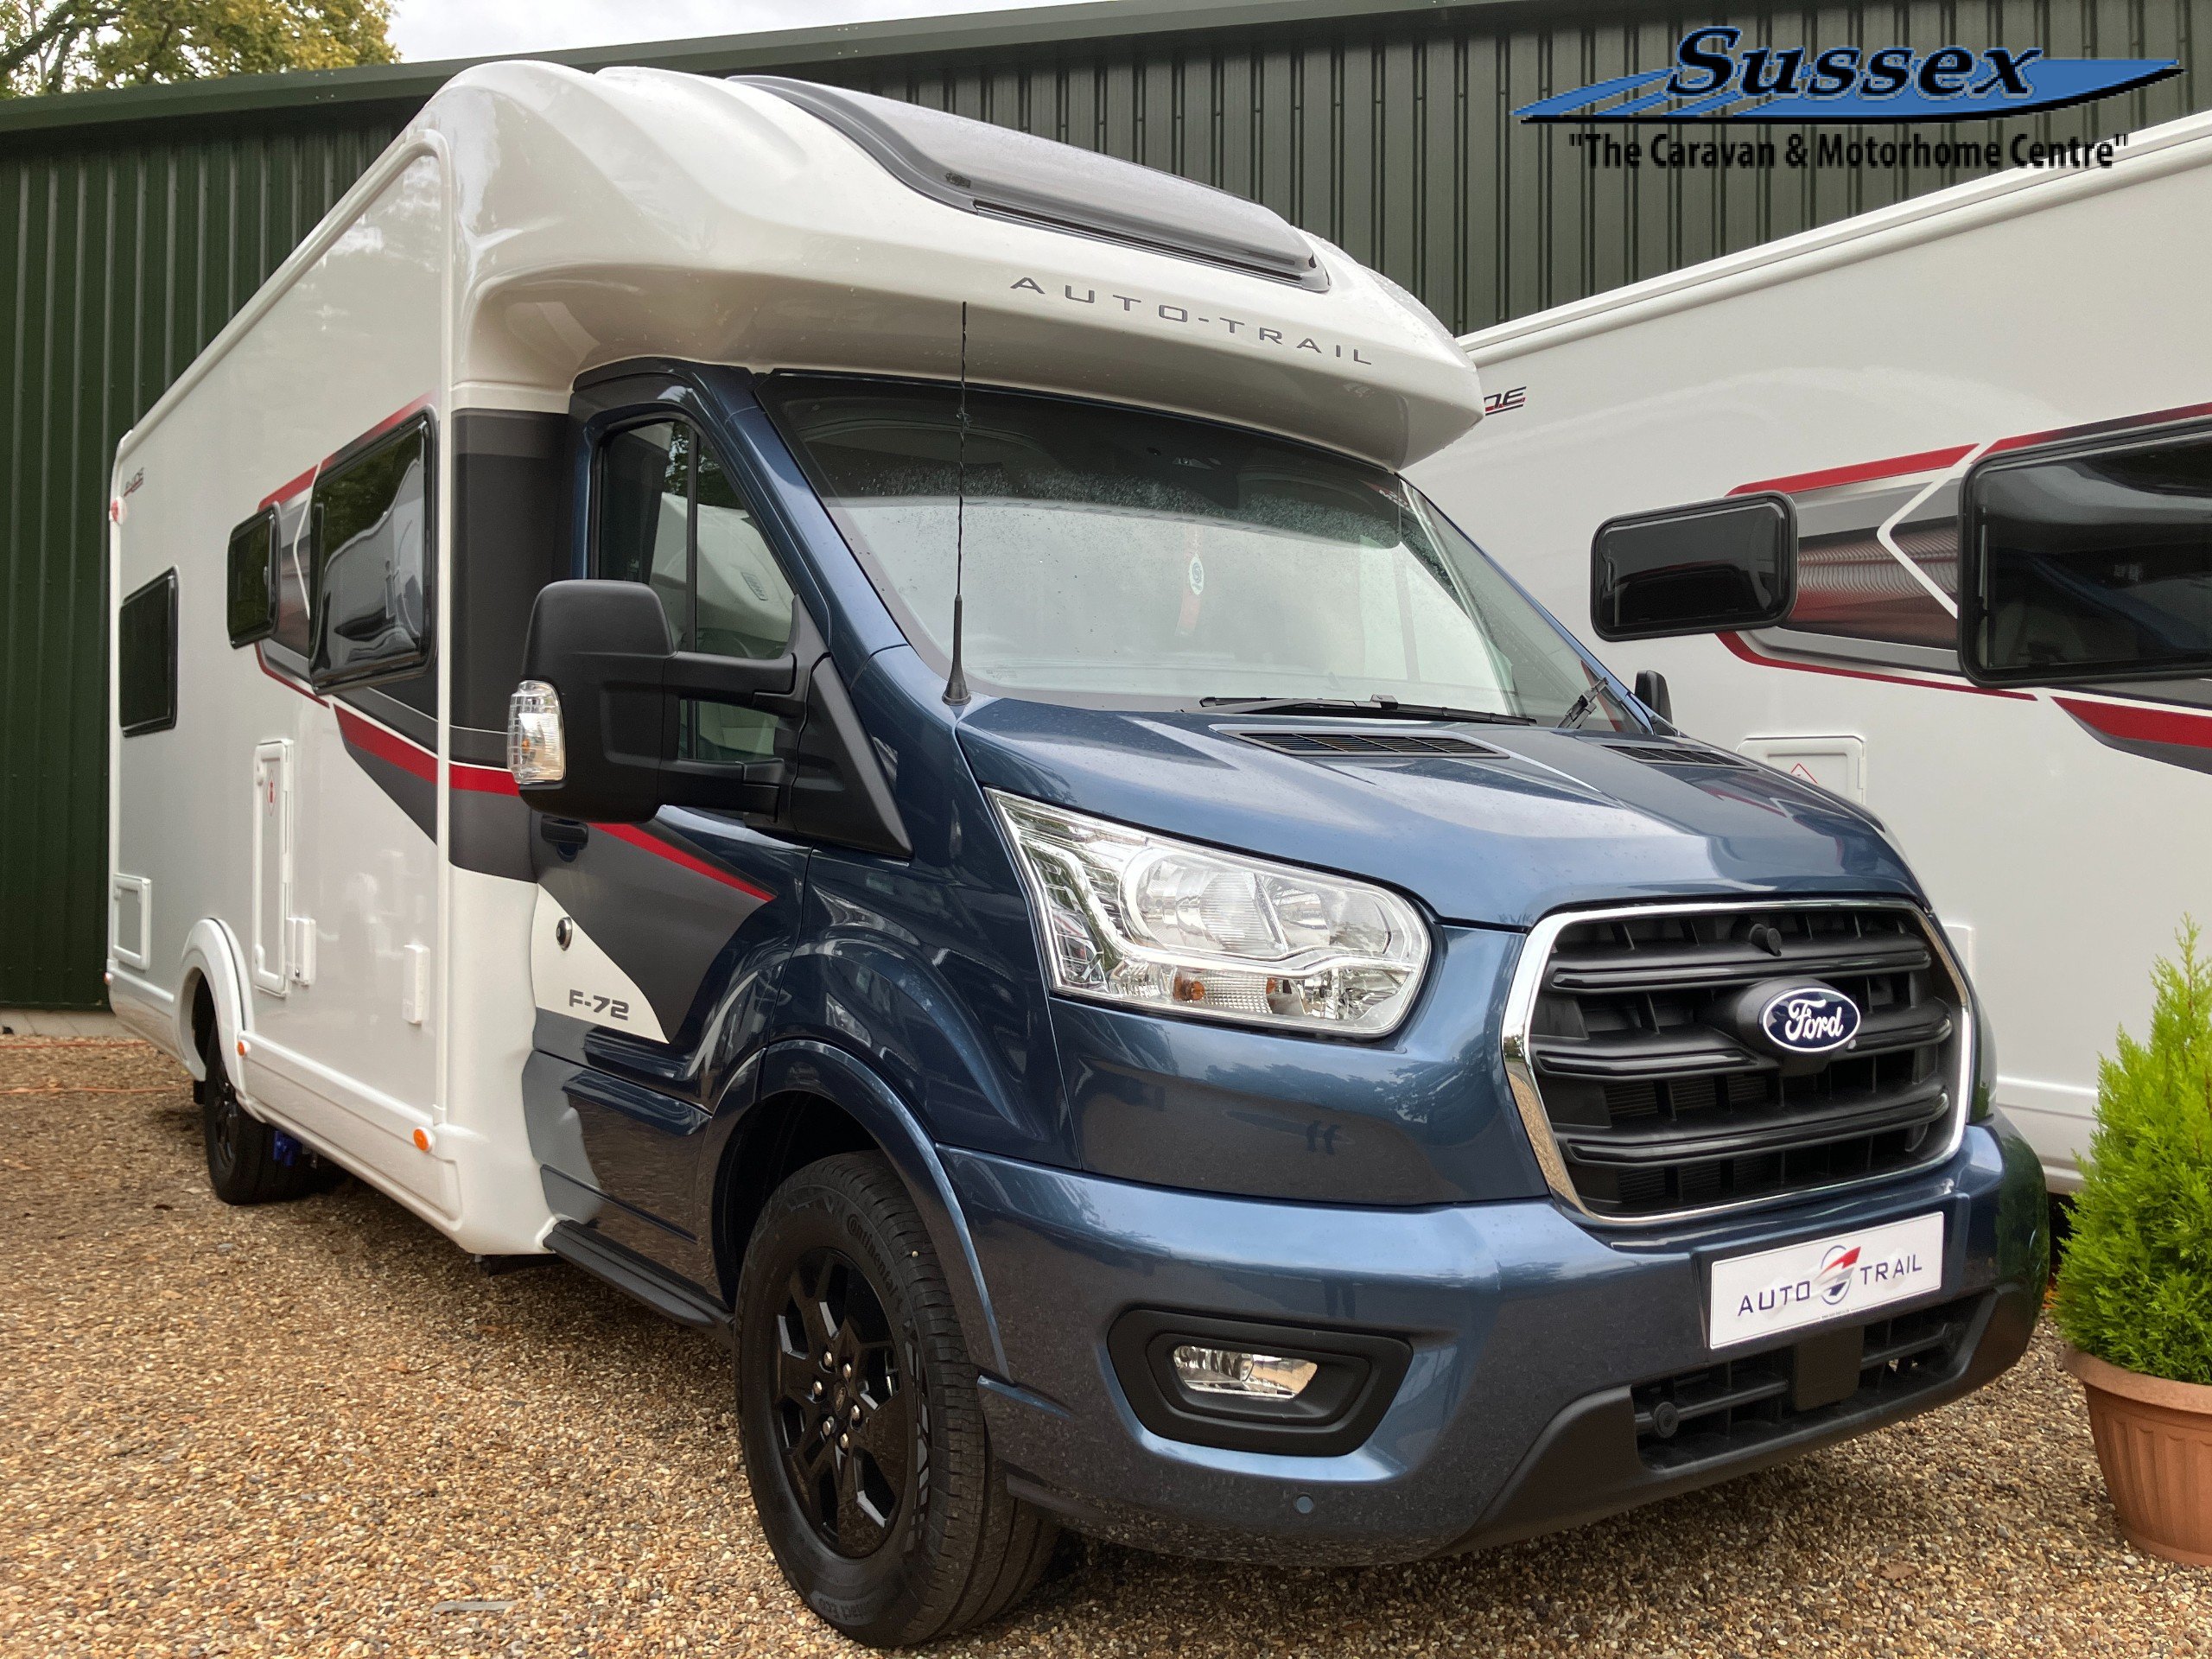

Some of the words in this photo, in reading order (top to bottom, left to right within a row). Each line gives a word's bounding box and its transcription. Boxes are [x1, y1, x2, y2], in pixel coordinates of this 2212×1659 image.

[1009, 276, 1372, 365] AUTO-TRAIL
[569, 988, 630, 1020] F-72
[1785, 999, 1844, 1040] Ford
[1738, 1281, 1810, 1317] AUTO
[1860, 1255, 1923, 1285] TRAIL
